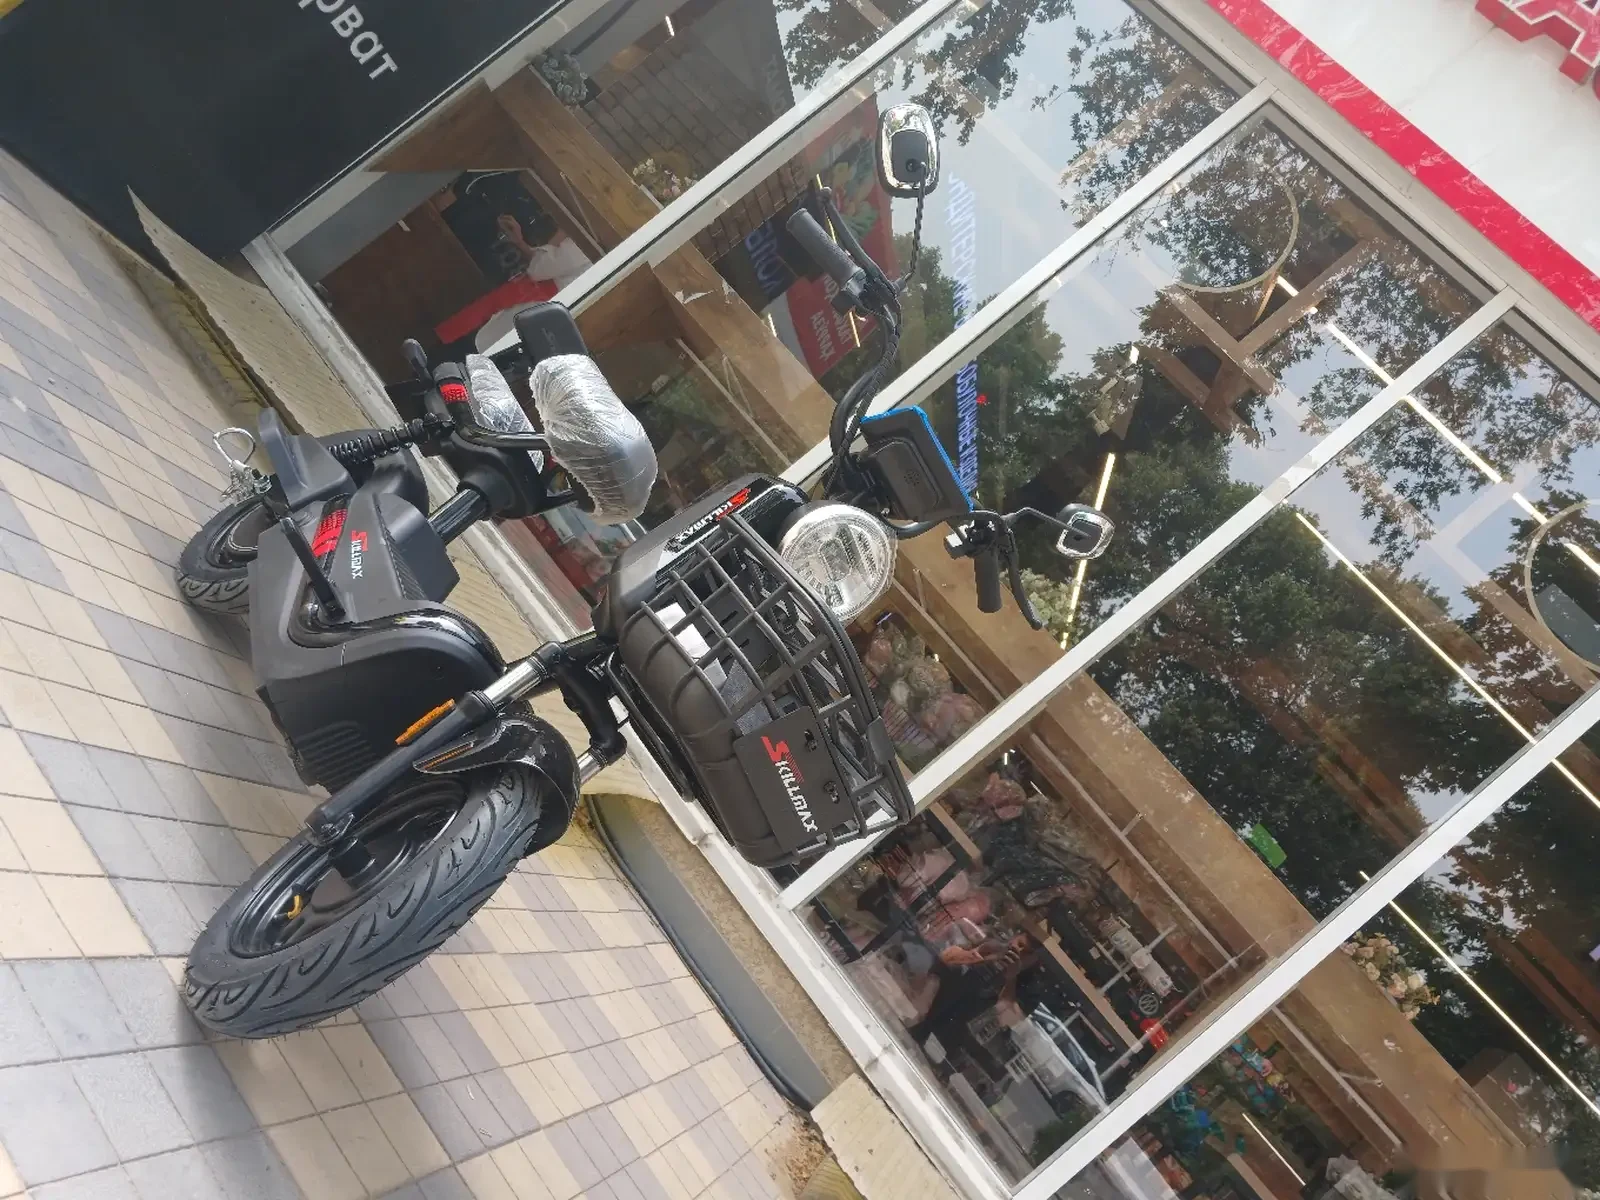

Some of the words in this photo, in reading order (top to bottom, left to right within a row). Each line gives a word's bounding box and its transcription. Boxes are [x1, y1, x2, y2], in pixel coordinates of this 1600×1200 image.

[957, 362, 978, 452] ОБУЛОЧНЫЕ
[675, 487, 752, 542] SKILLMAX
[350, 530, 369, 580] SKILLMAX
[760, 735, 819, 833] SKILLMAX
